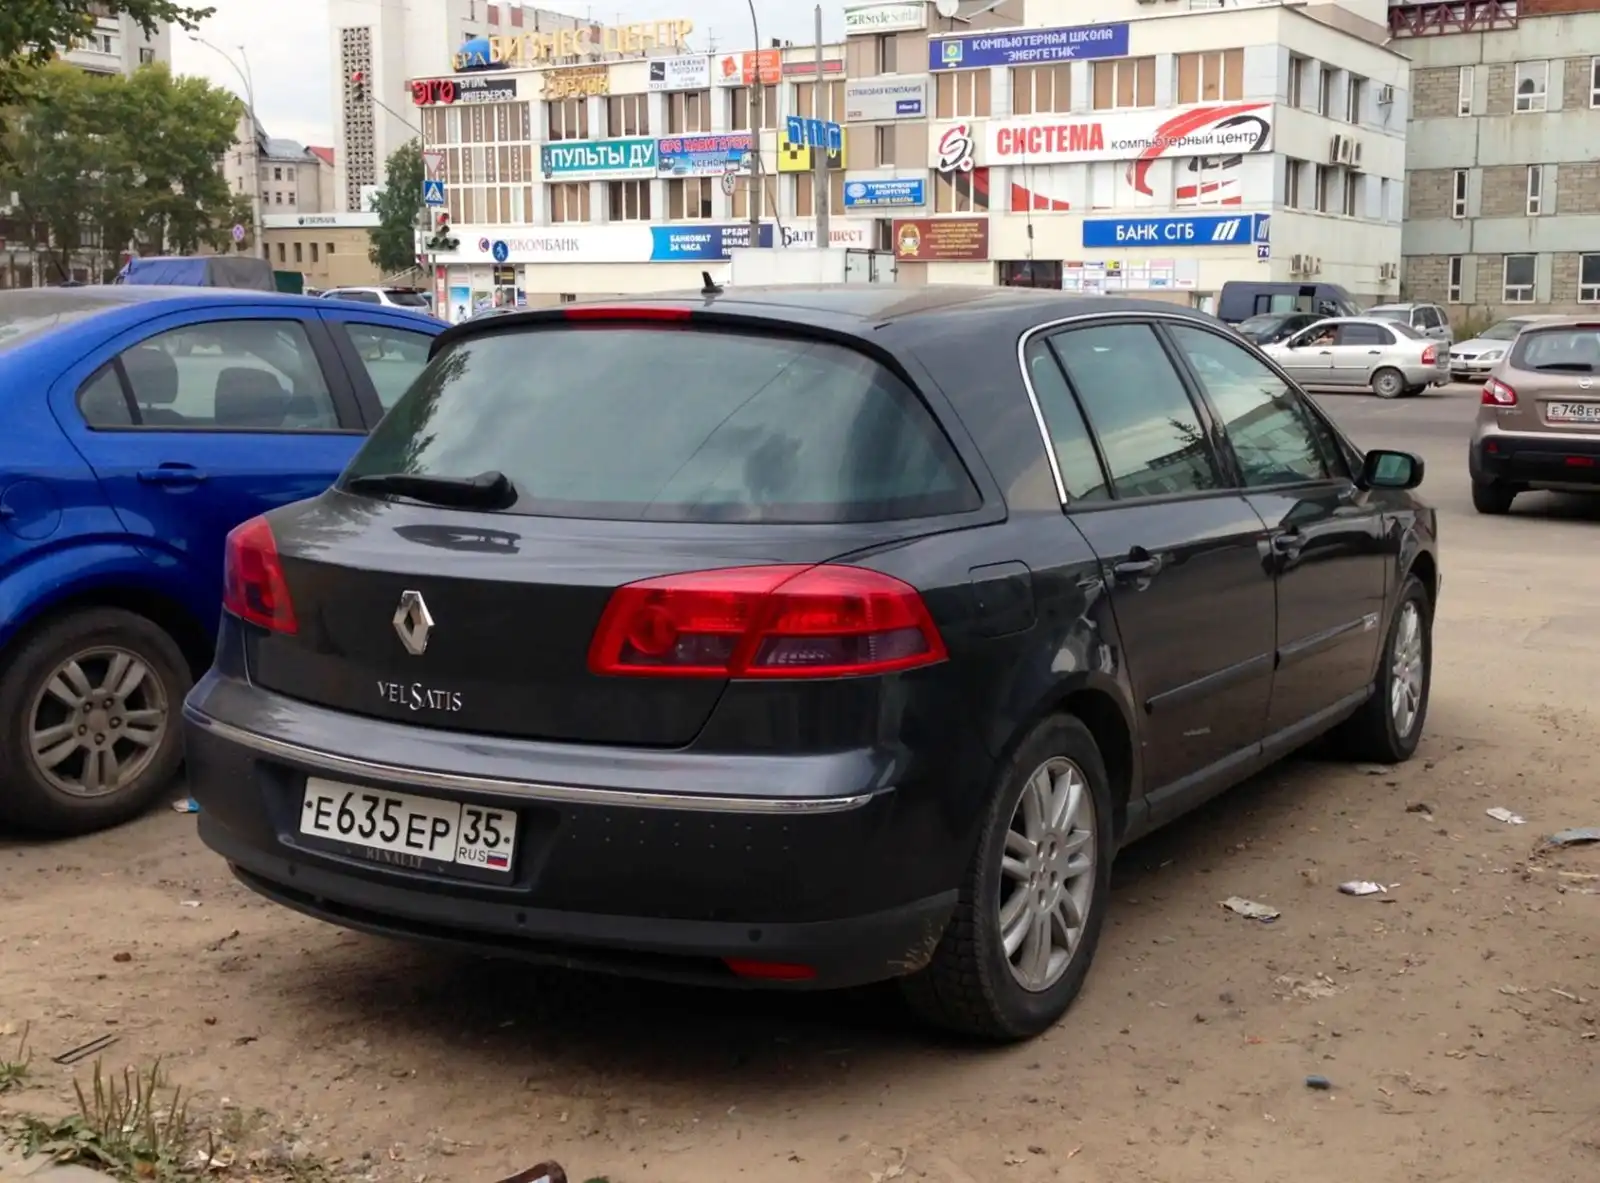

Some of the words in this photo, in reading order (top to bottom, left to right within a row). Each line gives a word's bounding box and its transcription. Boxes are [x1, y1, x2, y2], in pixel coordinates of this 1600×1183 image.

[488, 27, 592, 63] БИЗНЕС
[603, 18, 694, 54] ЦЕНТР
[972, 32, 1067, 51] КОМПЬЮТЕРНАЯ
[1069, 28, 1114, 42] ШКОЛА
[683, 135, 753, 153] НАВИГАТОР
[997, 123, 1105, 155] СИСТЕМА
[1111, 133, 1213, 150] компьютерный
[1216, 132, 1258, 149] центр
[551, 146, 625, 168] ПУЛЬТЫ
[629, 143, 654, 167] ДУ
[691, 158, 726, 168] КСЕНОН
[669, 234, 712, 243] БАНКОМАТ
[721, 227, 761, 236] КРЕДИ
[781, 226, 864, 248] Балтвест
[1116, 224, 1159, 241] БАНК
[1164, 222, 1195, 240] СГБ
[494, 238, 579, 251] ВКОМБАНК
[680, 243, 702, 252] ЧАСА
[721, 238, 750, 246] ВКЛАД
[313, 792, 450, 851] Е635ЕР
[463, 809, 504, 848] 35
[458, 846, 486, 863] RUS
